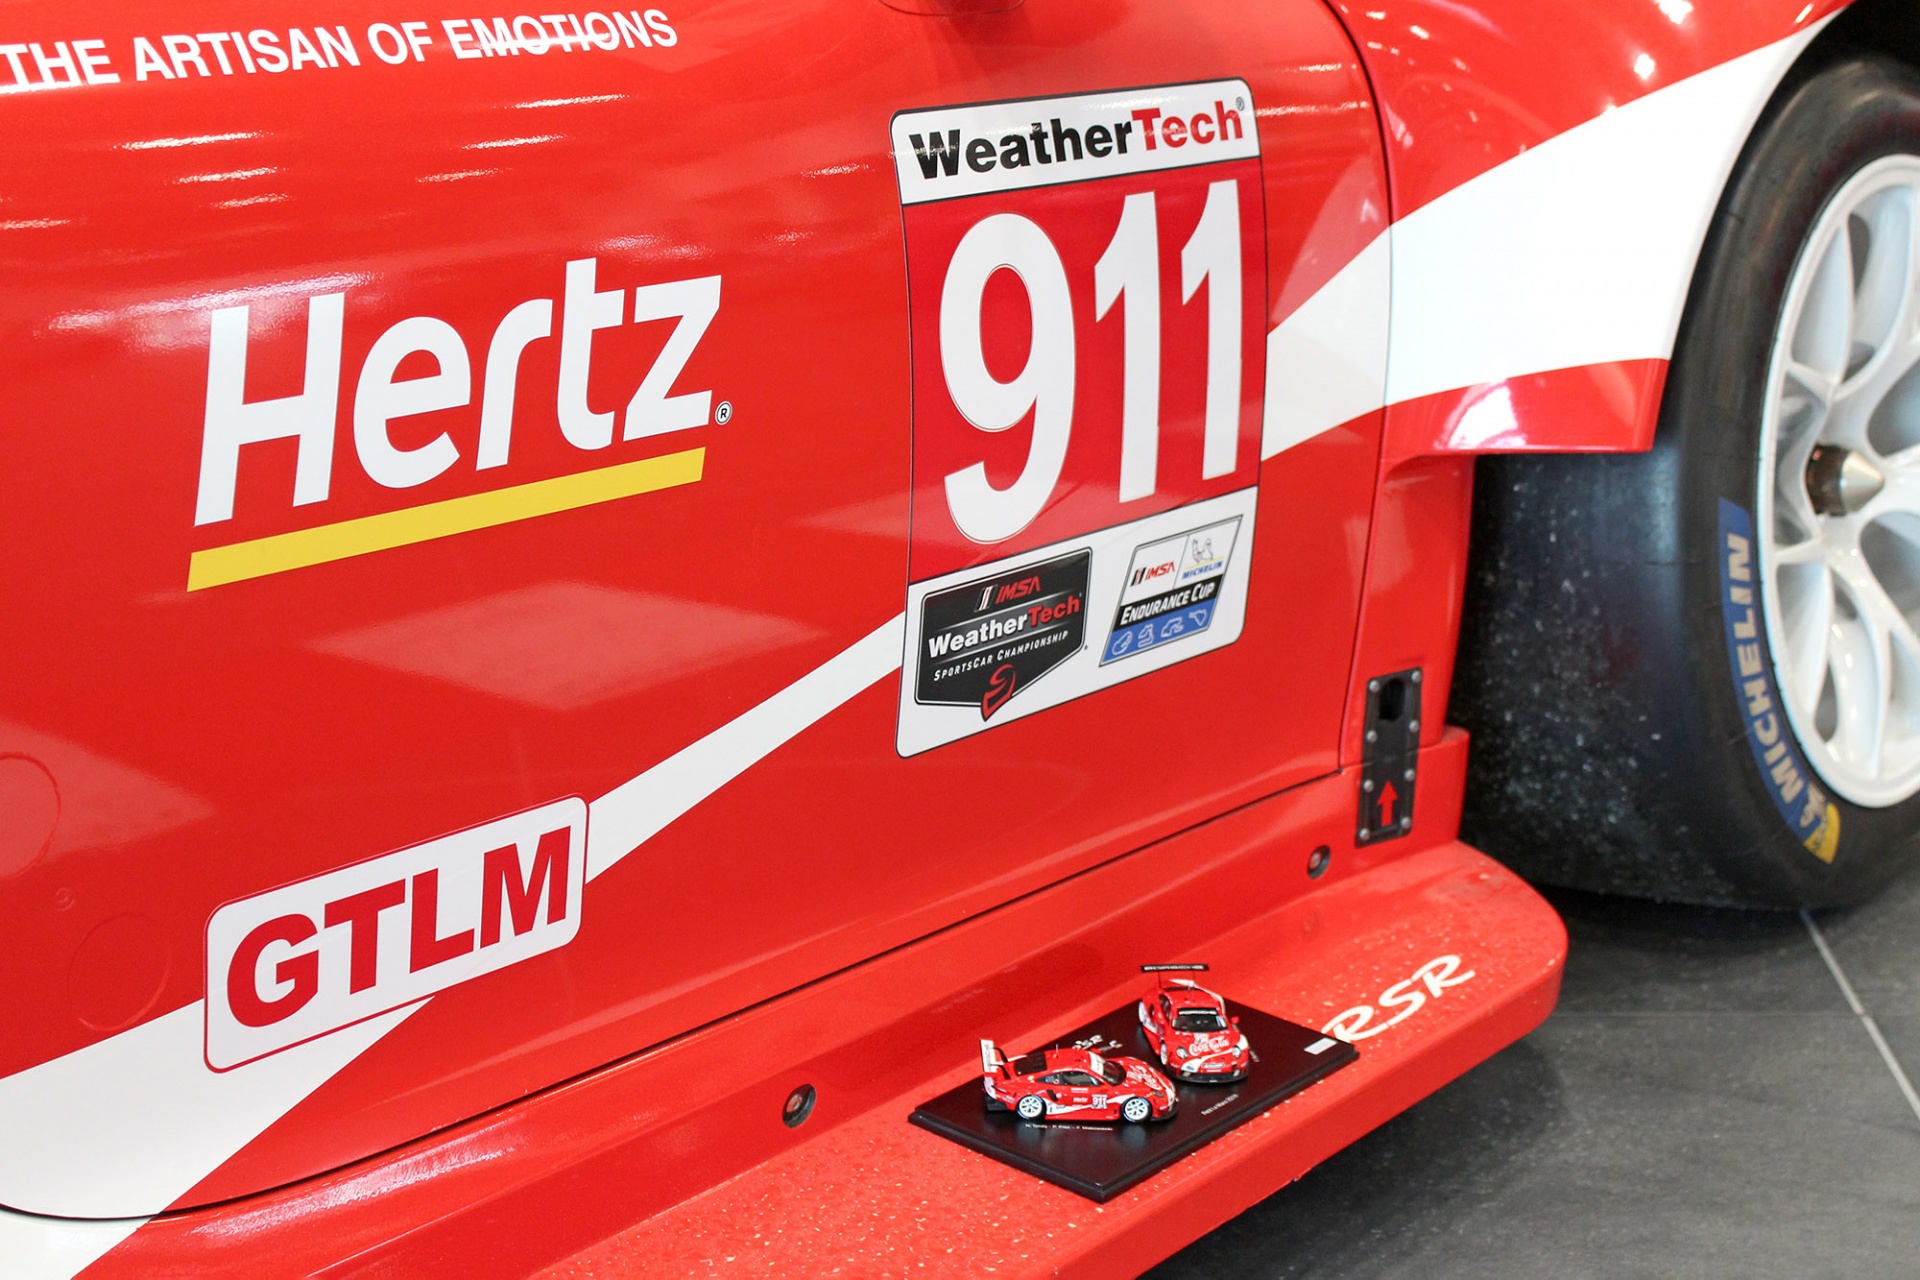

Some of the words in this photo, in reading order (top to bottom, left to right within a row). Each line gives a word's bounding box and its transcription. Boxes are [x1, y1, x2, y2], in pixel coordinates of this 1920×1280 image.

[0, 39, 120, 87] THE
[133, 25, 361, 82] ARTISAN
[367, 21, 428, 64] OF
[441, 9, 678, 59] EMOTIONS
[909, 101, 1243, 179] WeatherTech
[194, 257, 722, 526] Hertz
[940, 179, 1242, 544] 911
[995, 576, 1041, 604] IMSA
[1145, 561, 1175, 580] IMSA
[1182, 560, 1223, 580] MICHELIN
[928, 595, 1080, 658] WeatherTech
[1727, 532, 1802, 804] MICHELIN
[227, 825, 571, 1028] GTLM
[1320, 955, 1475, 1041] RSR
[1092, 1097, 1107, 1107] 911
